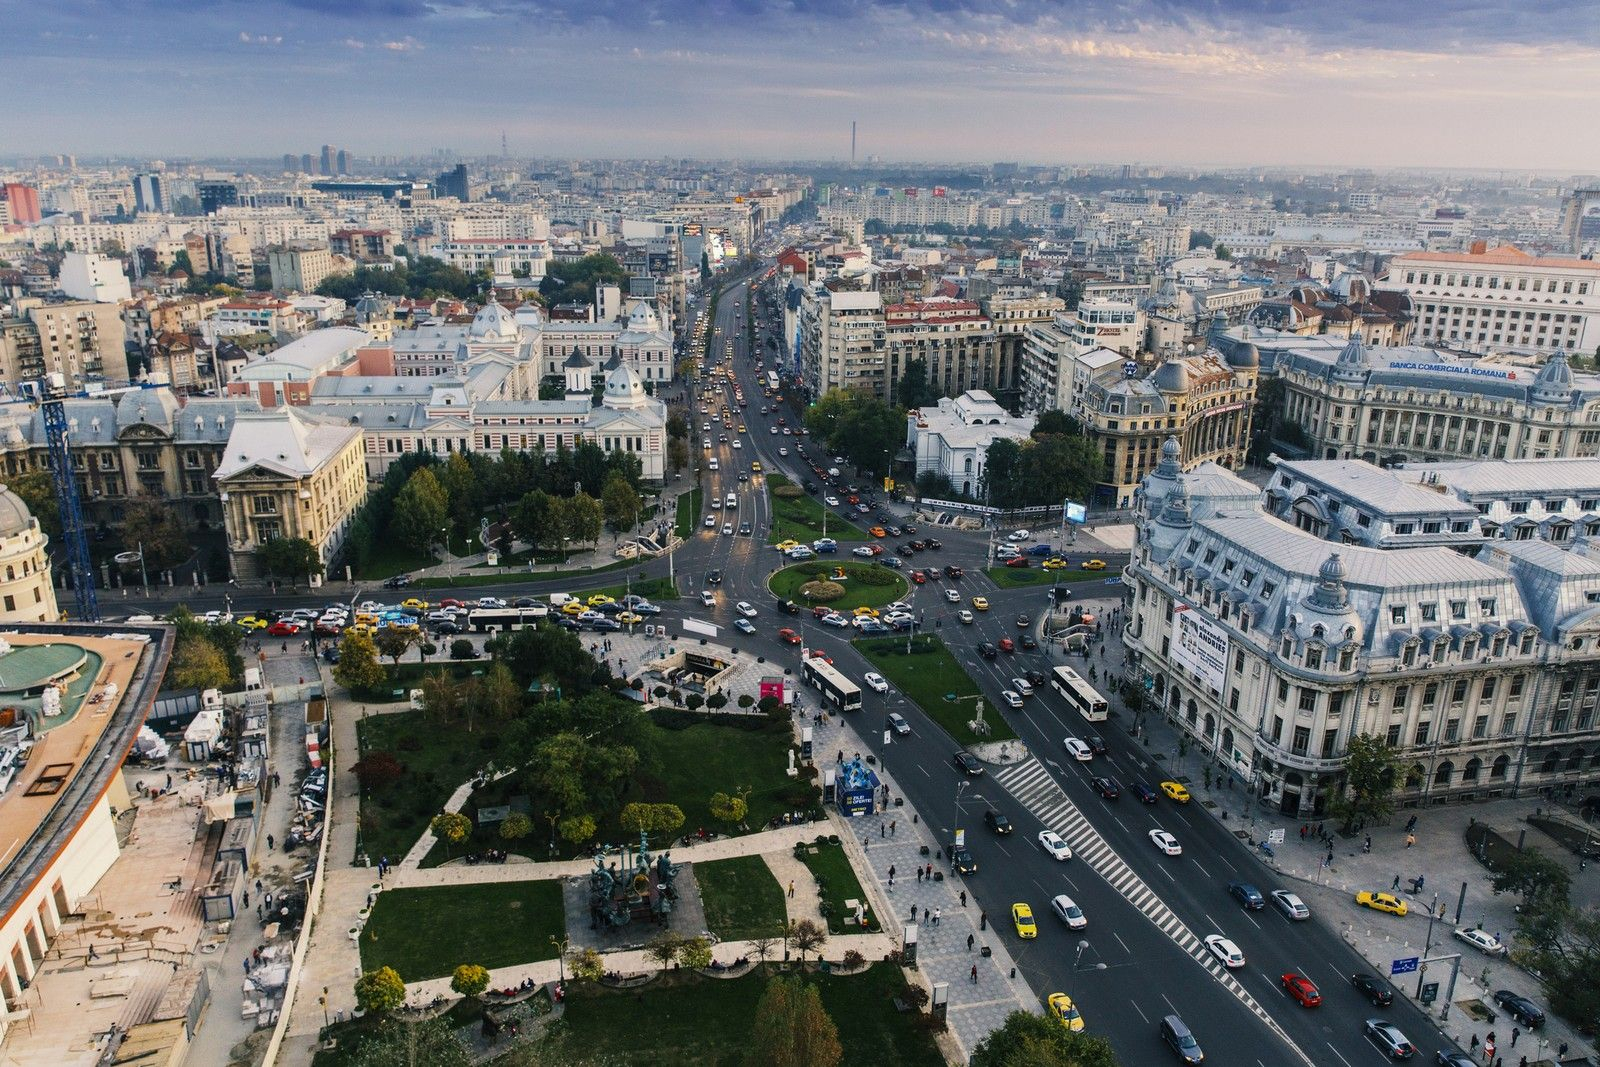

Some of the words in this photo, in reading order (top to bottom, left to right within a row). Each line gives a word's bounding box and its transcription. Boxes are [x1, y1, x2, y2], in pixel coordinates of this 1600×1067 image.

[1389, 361, 1417, 369] BANCA
[1418, 363, 1469, 374] COMERCIALA
[1470, 368, 1507, 379] ROMANA
[1199, 624, 1226, 646] alexandru
